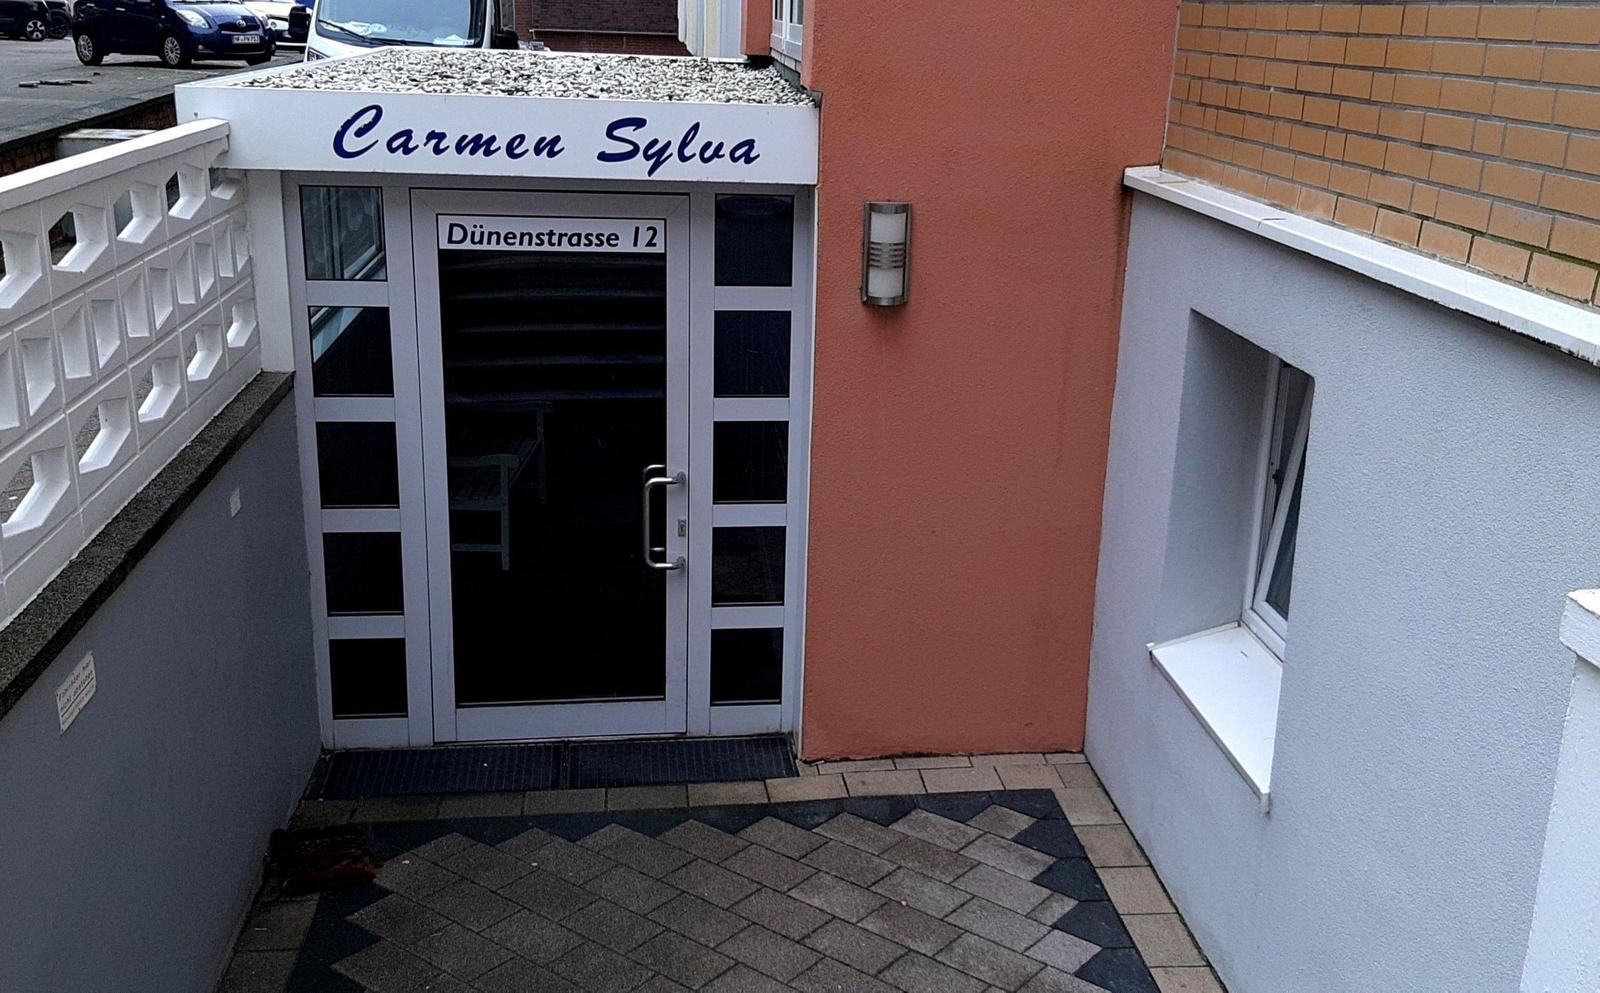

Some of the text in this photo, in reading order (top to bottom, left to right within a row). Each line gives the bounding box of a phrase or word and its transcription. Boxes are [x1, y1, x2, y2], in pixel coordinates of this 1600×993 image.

[333, 104, 760, 177] Carmen Sylva
[447, 222, 659, 248] Dünenstrasse 12
